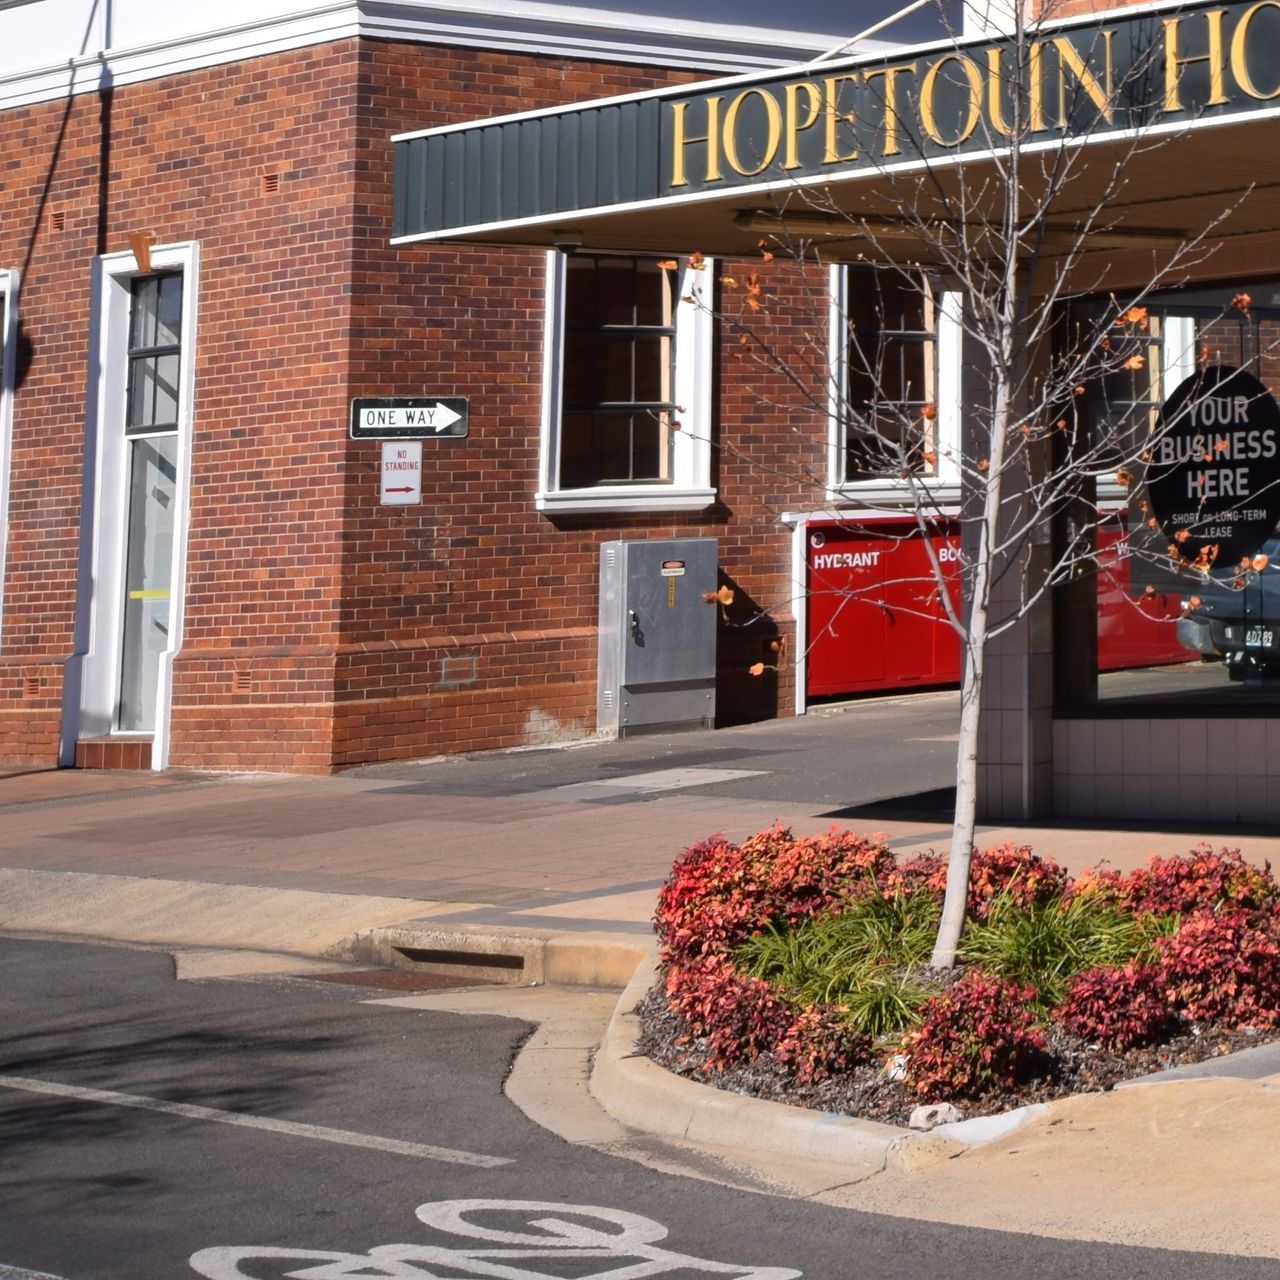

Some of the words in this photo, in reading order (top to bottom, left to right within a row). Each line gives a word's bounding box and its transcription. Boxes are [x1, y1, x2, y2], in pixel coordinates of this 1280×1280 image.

[669, 30, 1117, 187] HOPETOUN
[367, 410, 396, 425] ONE
[405, 410, 436, 425] WAY
[1186, 395, 1249, 427] YOUR
[397, 450, 407, 459] NO
[1160, 429, 1276, 464] BUSINESS
[385, 461, 419, 471] STANDING
[1187, 467, 1249, 499] HERE
[1171, 513, 1201, 524] SHORT
[1215, 509, 1267, 522] LONG-TERM
[1205, 526, 1232, 538] LEASE
[814, 552, 880, 569] HYDRANT
